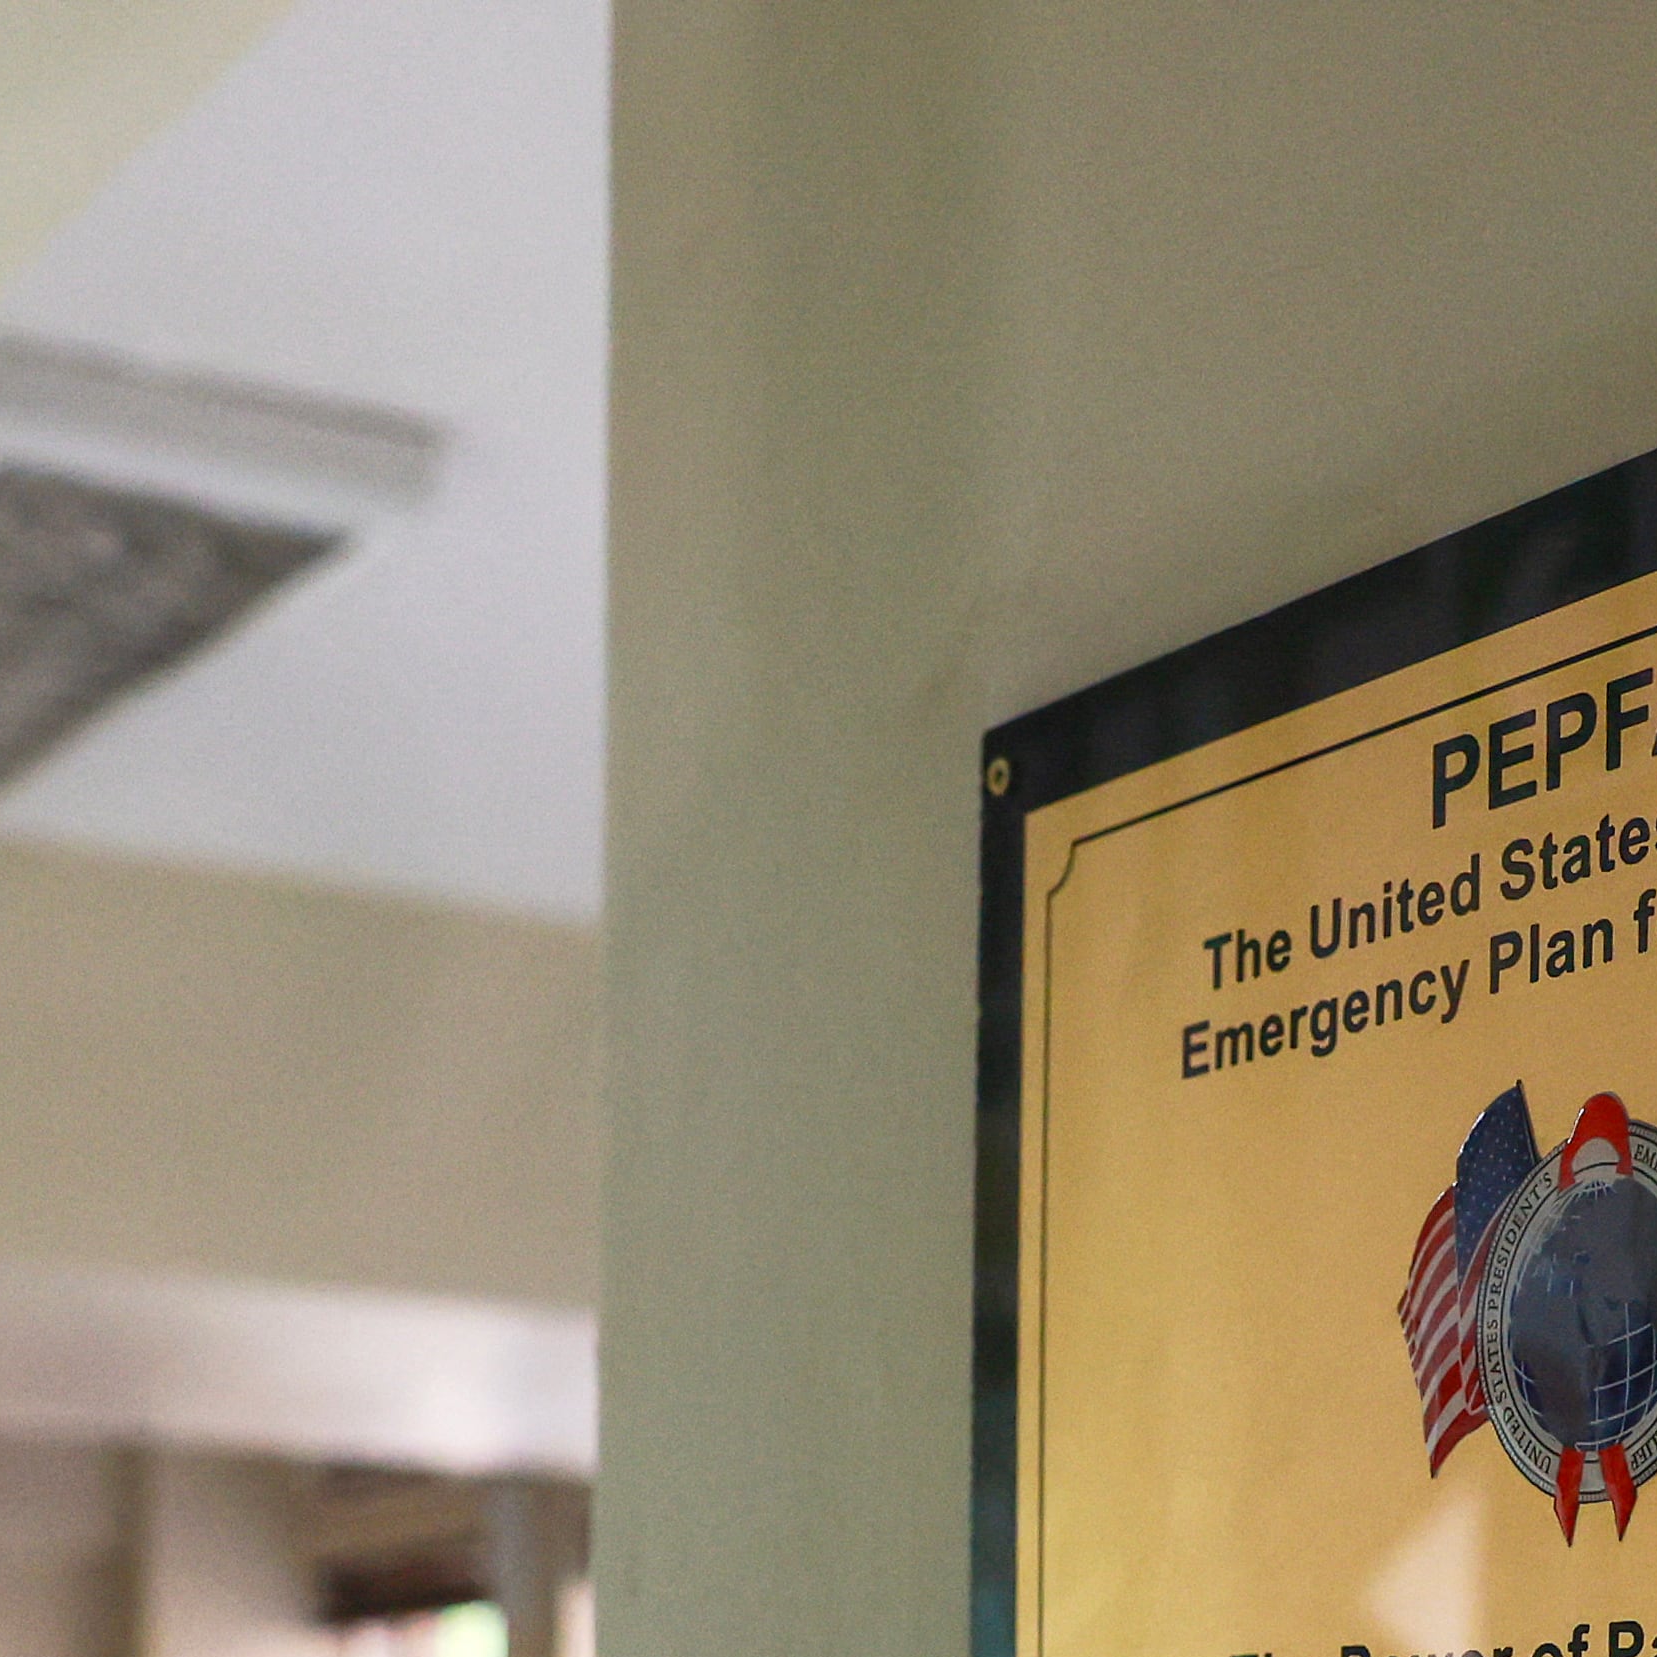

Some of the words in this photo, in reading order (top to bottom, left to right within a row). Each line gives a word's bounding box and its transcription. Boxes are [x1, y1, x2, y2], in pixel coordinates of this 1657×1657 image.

[1202, 927, 1293, 990] The
[1309, 877, 1482, 960] United
[1180, 958, 1472, 1080] Emergency
[1488, 917, 1615, 996] Plan
[1486, 1318, 1507, 1404] STATES
[1503, 1406, 1552, 1475] UNITED
